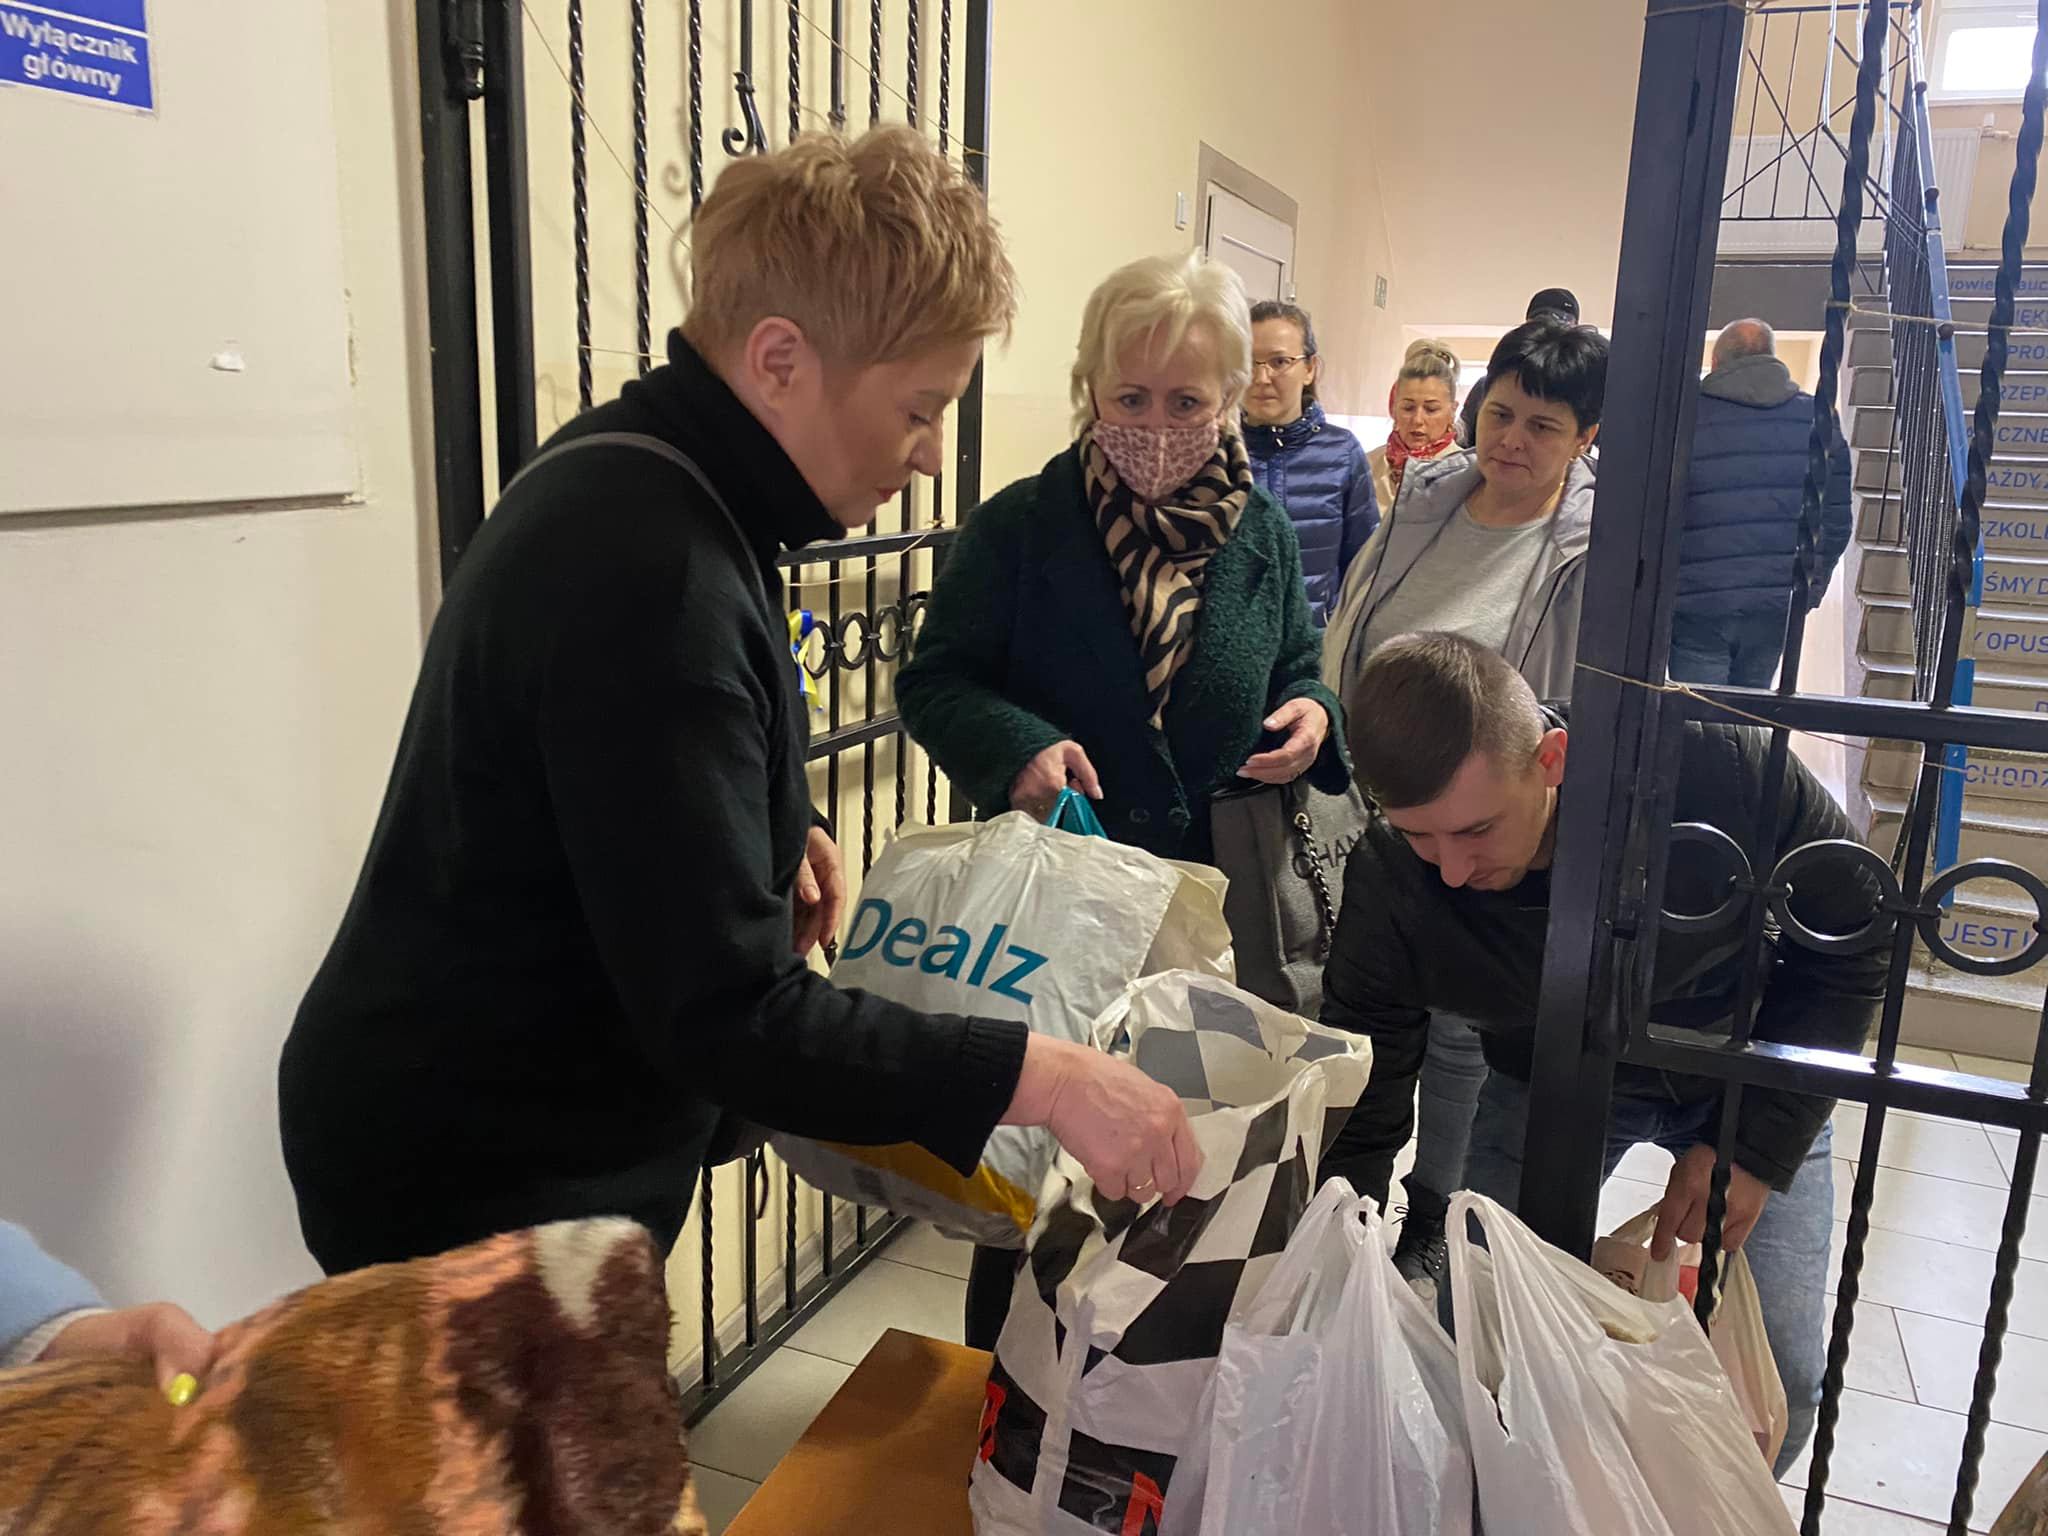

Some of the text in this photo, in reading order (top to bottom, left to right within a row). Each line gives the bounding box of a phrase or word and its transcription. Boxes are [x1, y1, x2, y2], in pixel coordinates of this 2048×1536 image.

[0, 11, 139, 64] Wyłącznik
[23, 51, 122, 96] główny
[2006, 344, 2048, 360] PRO
[1997, 427, 2048, 444] CZNE
[1980, 520, 2048, 540] ZKOL
[1984, 571, 2033, 594] ŚMY
[1943, 921, 2018, 949] JEST
[840, 898, 1049, 1005] Dealz
